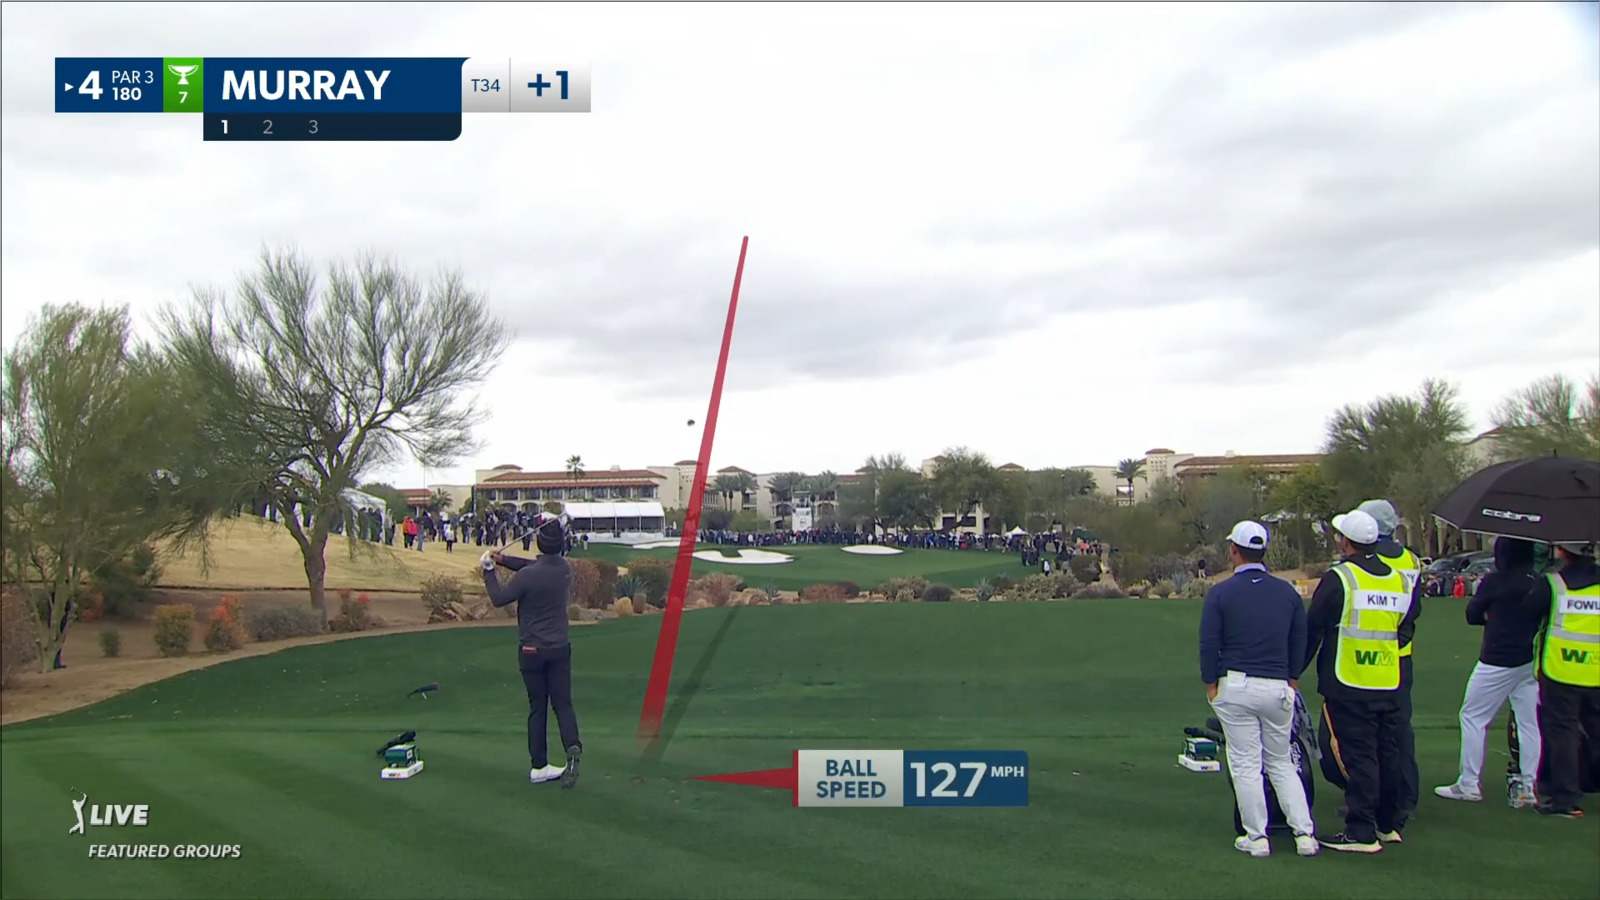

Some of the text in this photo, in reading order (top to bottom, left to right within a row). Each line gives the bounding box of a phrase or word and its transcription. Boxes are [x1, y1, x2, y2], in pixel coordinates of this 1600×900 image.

[1367, 594, 1398, 607] KIM T
[1355, 650, 1394, 666] WM
